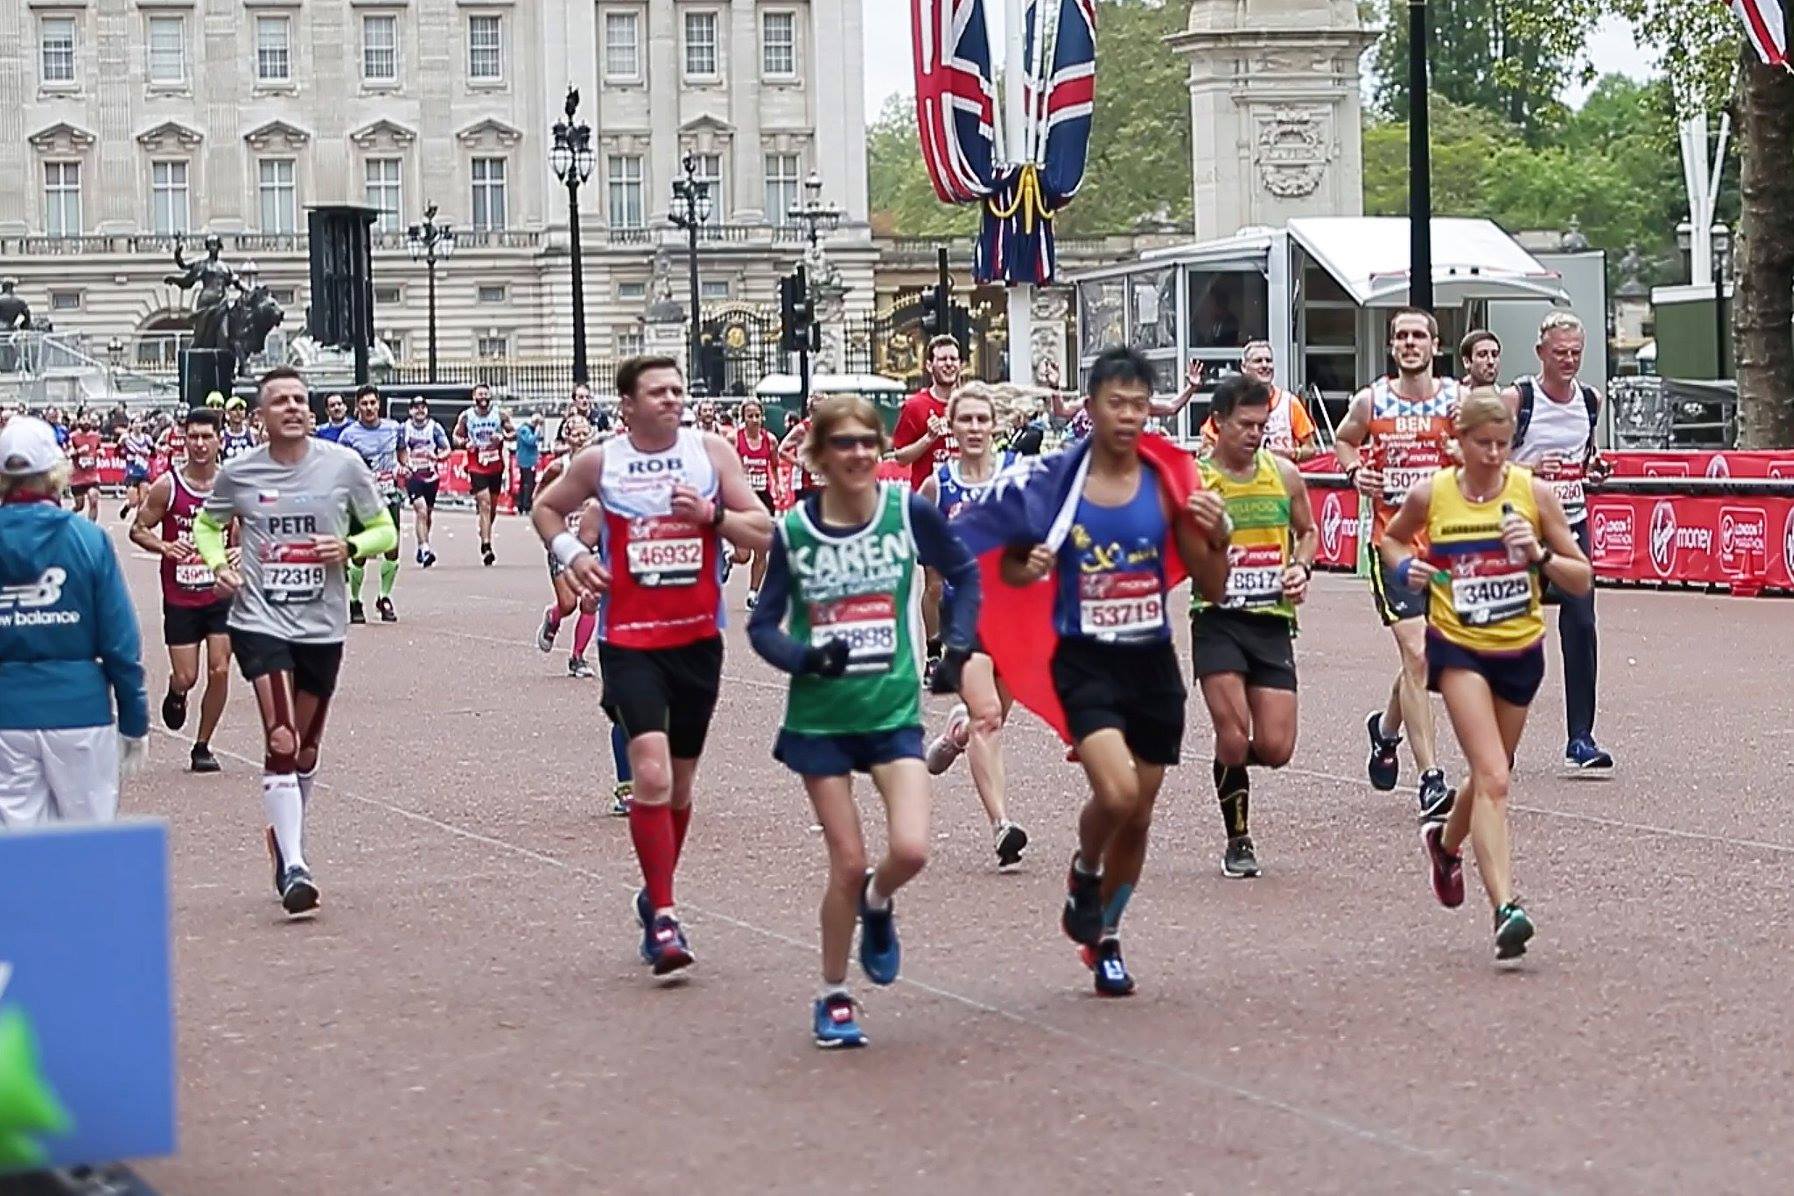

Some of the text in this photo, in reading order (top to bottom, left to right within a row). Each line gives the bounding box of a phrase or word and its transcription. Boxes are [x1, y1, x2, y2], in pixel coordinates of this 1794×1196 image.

[1395, 416, 1431, 432] BEN
[628, 457, 684, 474] ROB
[268, 515, 317, 535] PETR
[1676, 526, 1713, 556] money
[638, 544, 700, 565] 46932
[787, 530, 912, 577] KAREN
[271, 567, 323, 586] 72319
[15, 610, 81, 627] balance
[1092, 601, 1159, 626] 53719
